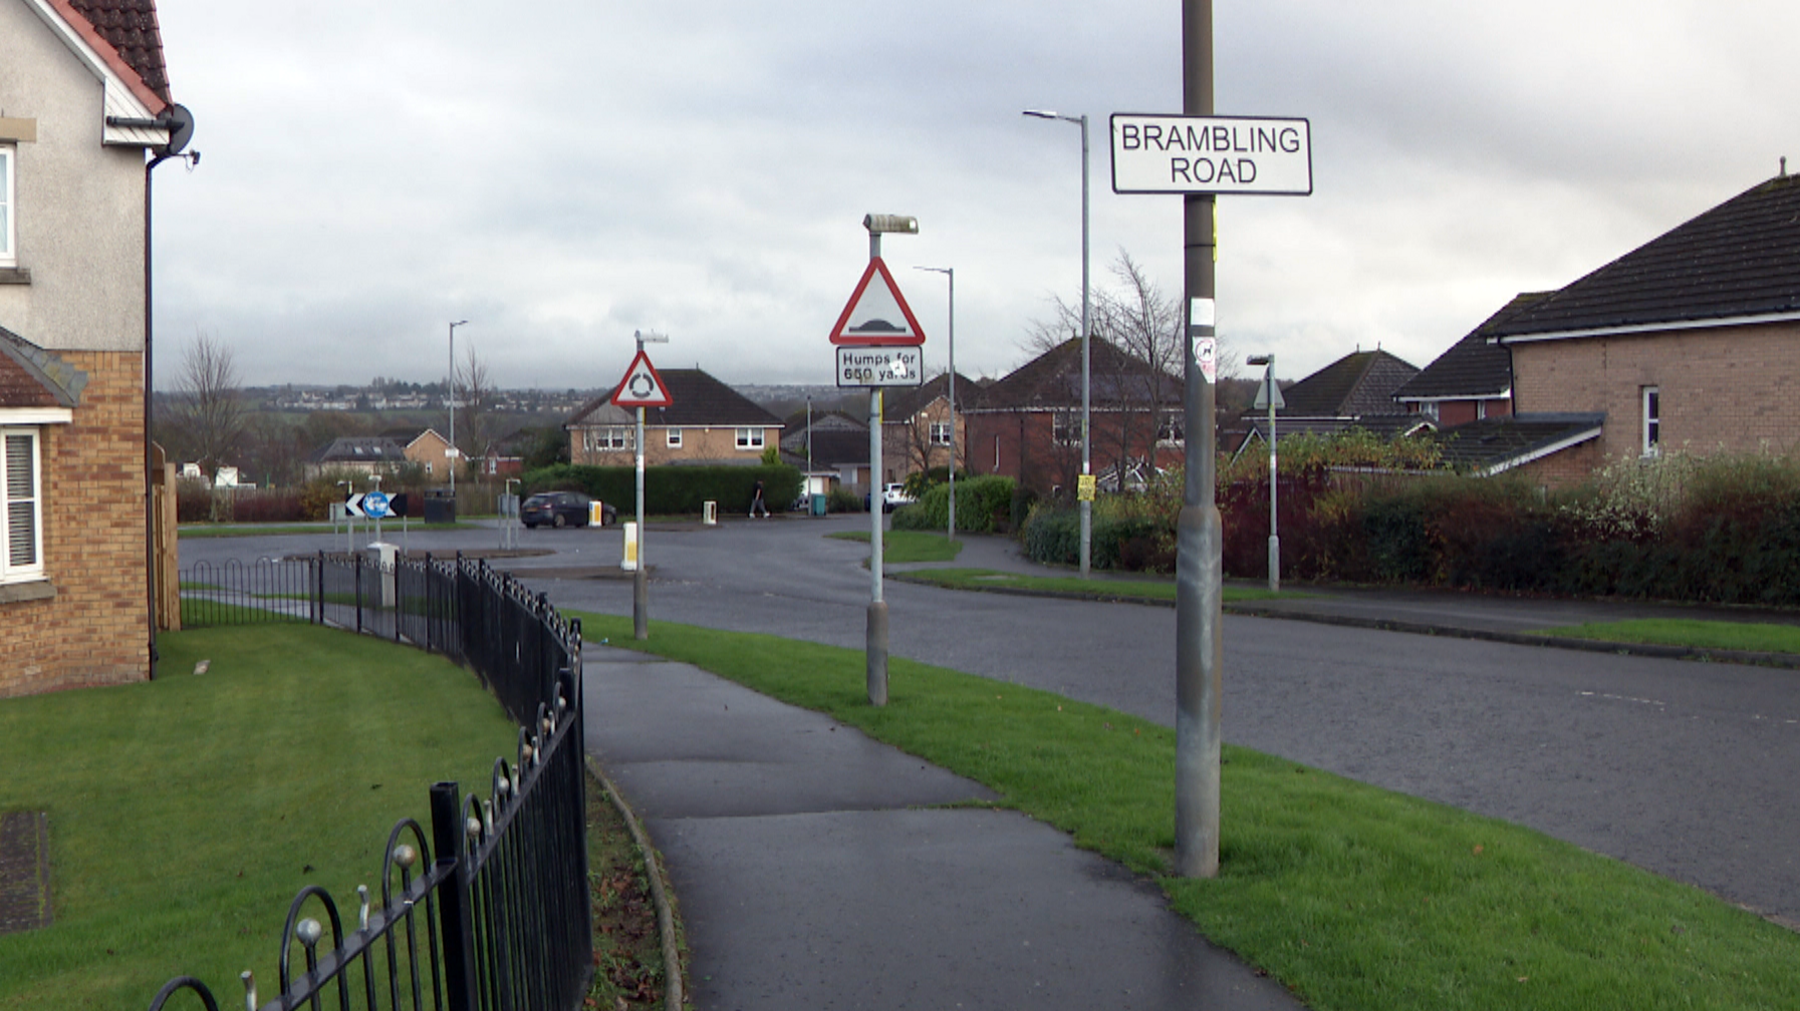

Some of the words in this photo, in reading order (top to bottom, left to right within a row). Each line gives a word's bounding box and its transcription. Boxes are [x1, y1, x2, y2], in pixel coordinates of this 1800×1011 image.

[1122, 124, 1300, 153] BRAMBLING
[1171, 157, 1257, 184] ROAD
[843, 352, 890, 366] Humps
